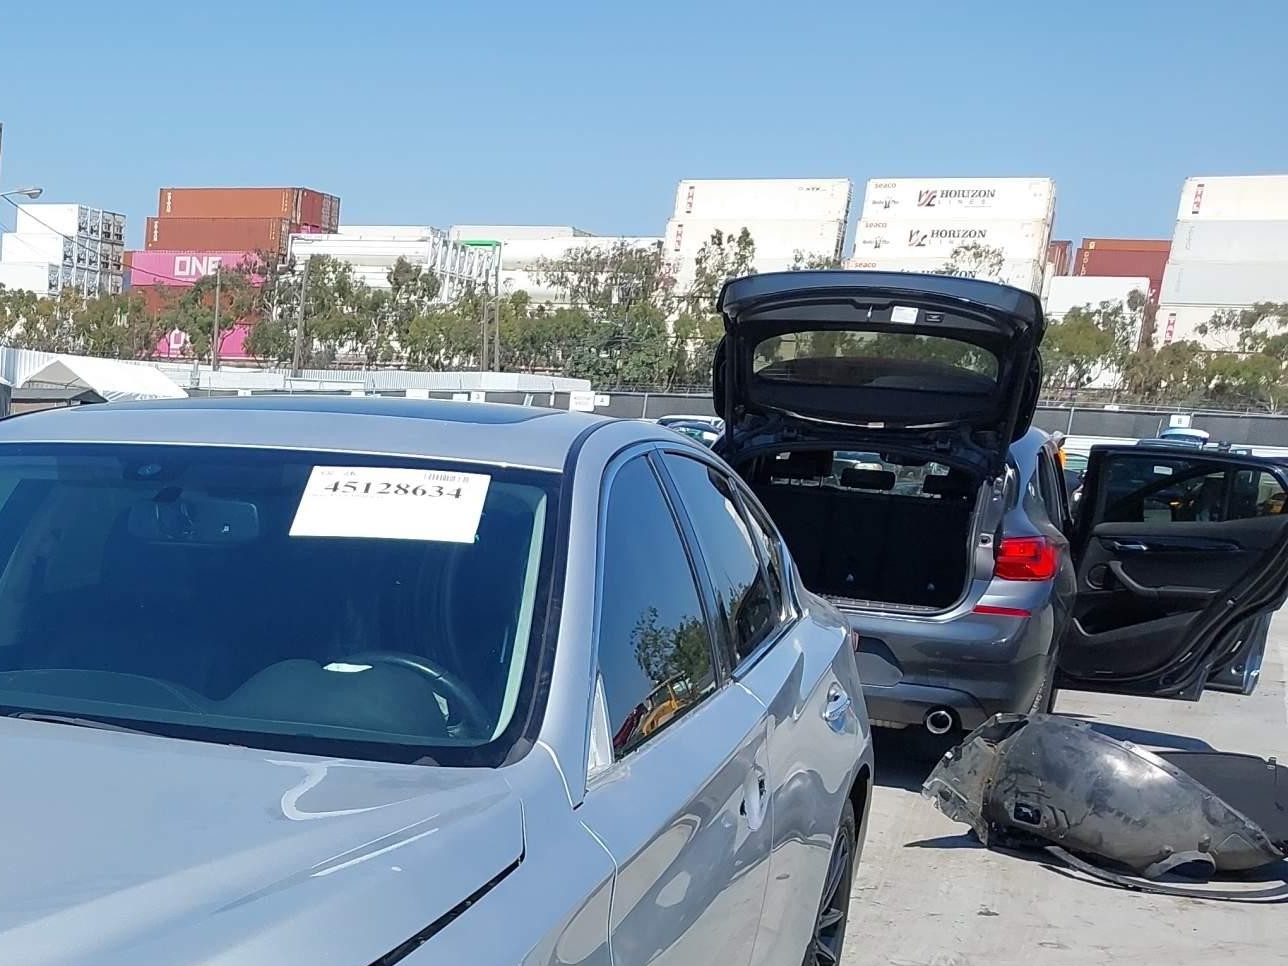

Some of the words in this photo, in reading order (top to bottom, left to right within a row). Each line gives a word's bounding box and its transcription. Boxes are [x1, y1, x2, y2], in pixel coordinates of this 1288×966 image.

[874, 181, 897, 189] seaco
[940, 189, 997, 198] HORIZON
[930, 229, 988, 238] HORIZON
[174, 256, 222, 276] ONE
[854, 261, 877, 269] seaco
[324, 481, 462, 499] 45128634
